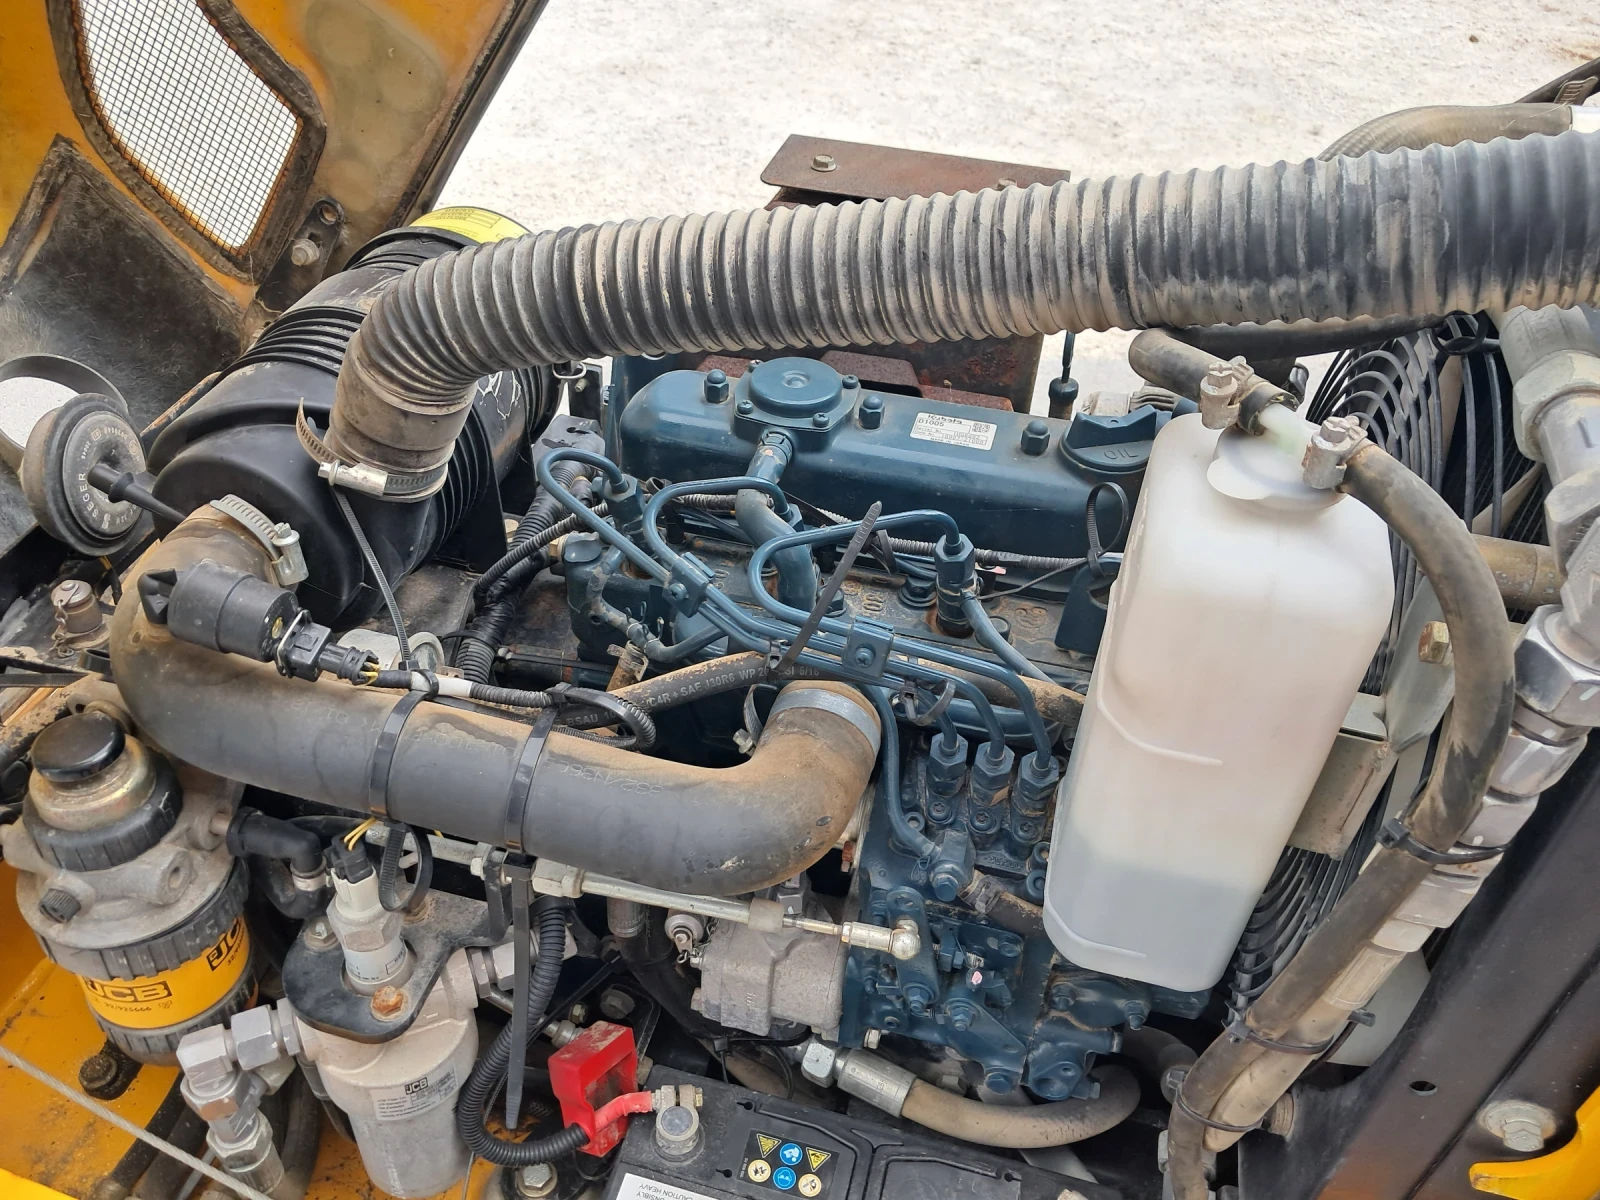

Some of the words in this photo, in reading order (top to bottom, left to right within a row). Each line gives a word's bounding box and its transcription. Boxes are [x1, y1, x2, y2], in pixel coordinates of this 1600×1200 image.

[1103, 448, 1139, 460] OIL
[78, 472, 99, 518] SEGER
[738, 668, 756, 681] WP
[406, 1077, 428, 1094] JCB
[639, 1183, 662, 1194] HEAVY
